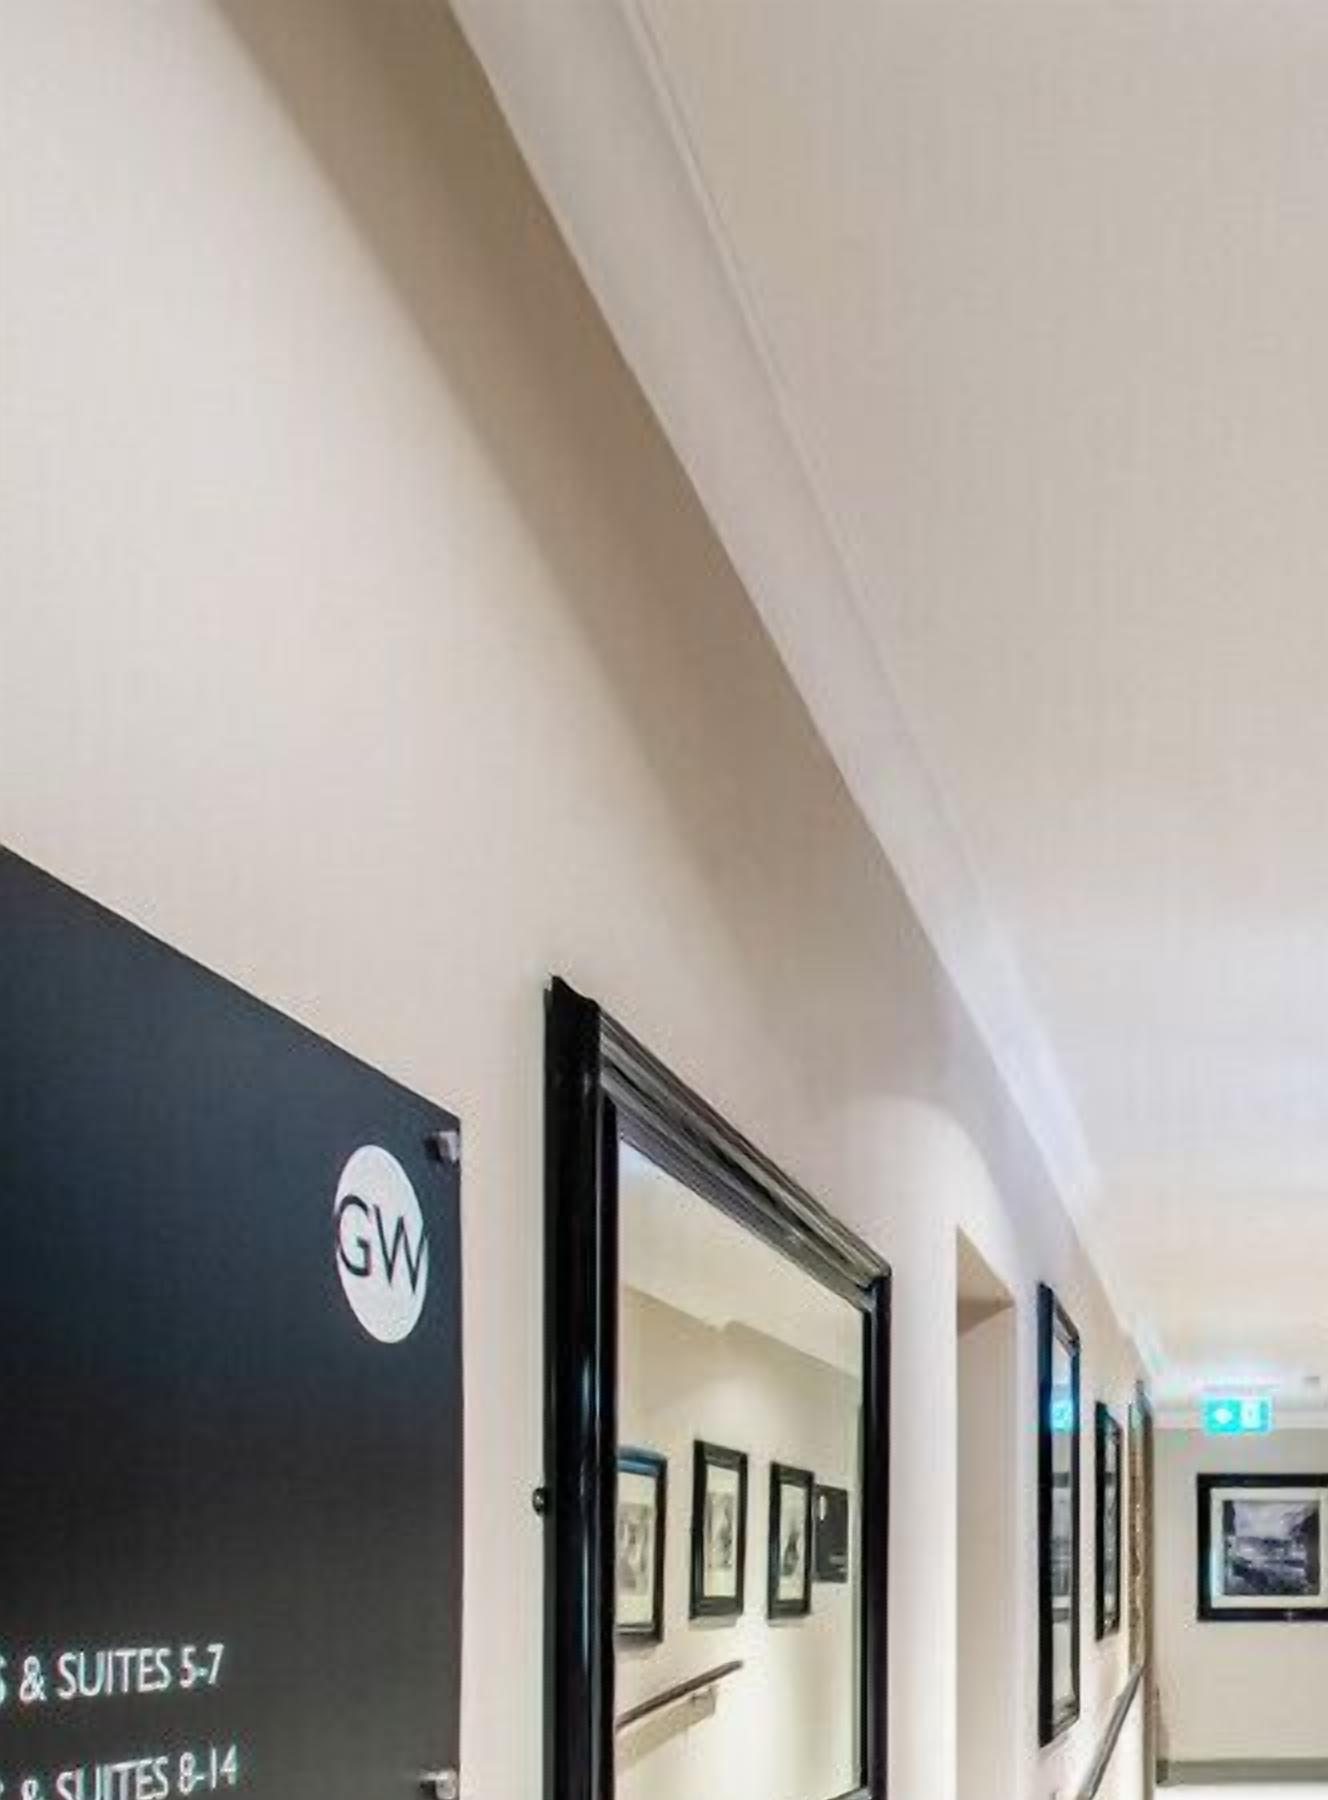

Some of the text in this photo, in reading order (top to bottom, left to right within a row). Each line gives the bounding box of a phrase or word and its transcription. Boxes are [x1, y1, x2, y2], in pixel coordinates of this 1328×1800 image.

[337, 1194, 427, 1296] GW
[19, 1655, 47, 1703] &
[57, 1647, 171, 1699] SUITES
[179, 1643, 225, 1688] 5-7
[178, 1744, 237, 1795] 8-14
